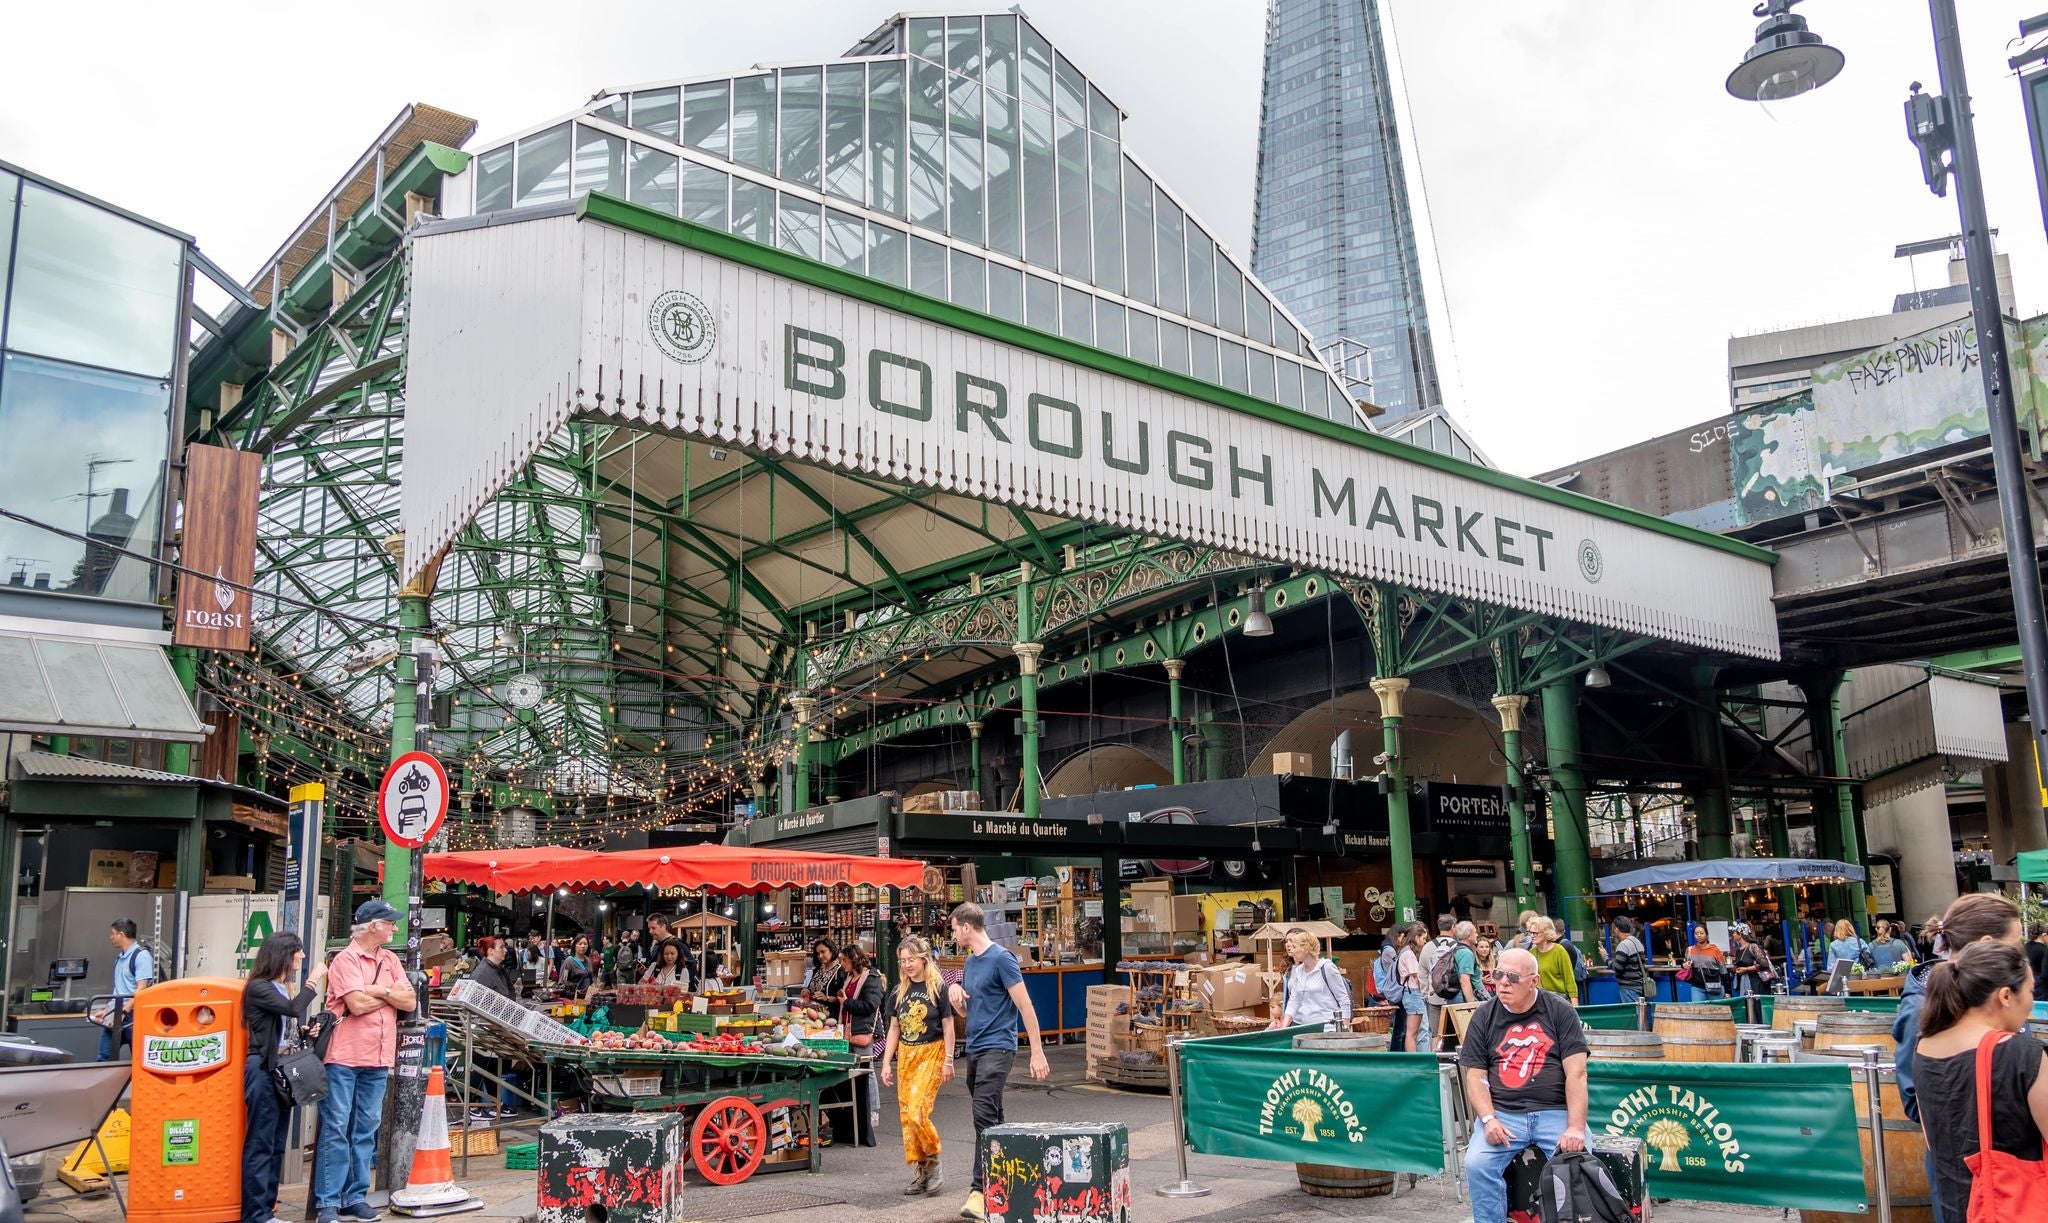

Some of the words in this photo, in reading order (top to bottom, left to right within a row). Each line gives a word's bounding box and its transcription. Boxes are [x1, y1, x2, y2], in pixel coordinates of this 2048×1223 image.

[652, 294, 687, 331] BOROUGH
[690, 300, 713, 345] MARKET
[1847, 352, 1896, 395] FAKE
[1895, 326, 1978, 377] PANDEMIC
[1690, 421, 1740, 452] SIDE
[784, 324, 1274, 507] BOROUGH
[1312, 468, 1553, 572] MARKET
[186, 609, 244, 629] roast
[973, 820, 983, 833] Le
[986, 821, 1017, 835] Marché
[1020, 822, 1030, 835] du
[1033, 822, 1067, 837] Quartier
[1344, 834, 1367, 845] Richard
[751, 861, 804, 881] BOROUGH
[806, 862, 852, 881] MARKET
[149, 1036, 221, 1051] VILLAINS
[161, 1049, 200, 1063] ONLY
[1260, 1068, 1301, 1135] TIMOTHY
[1308, 1068, 1368, 1143] TAYLOR'S
[1277, 1088, 1321, 1116] CHAMPIONSHIP
[1322, 1097, 1340, 1120] BEERS
[1285, 1126, 1300, 1135] EST.
[1320, 1129, 1336, 1137] 1858
[1605, 1085, 1658, 1137] MOTHY
[1668, 1085, 1750, 1173] TAYLOR'S
[1628, 1107, 1688, 1135] HAMPIONSHIP
[1690, 1118, 1713, 1146] BEERS
[1685, 1156, 1706, 1166] 1858
